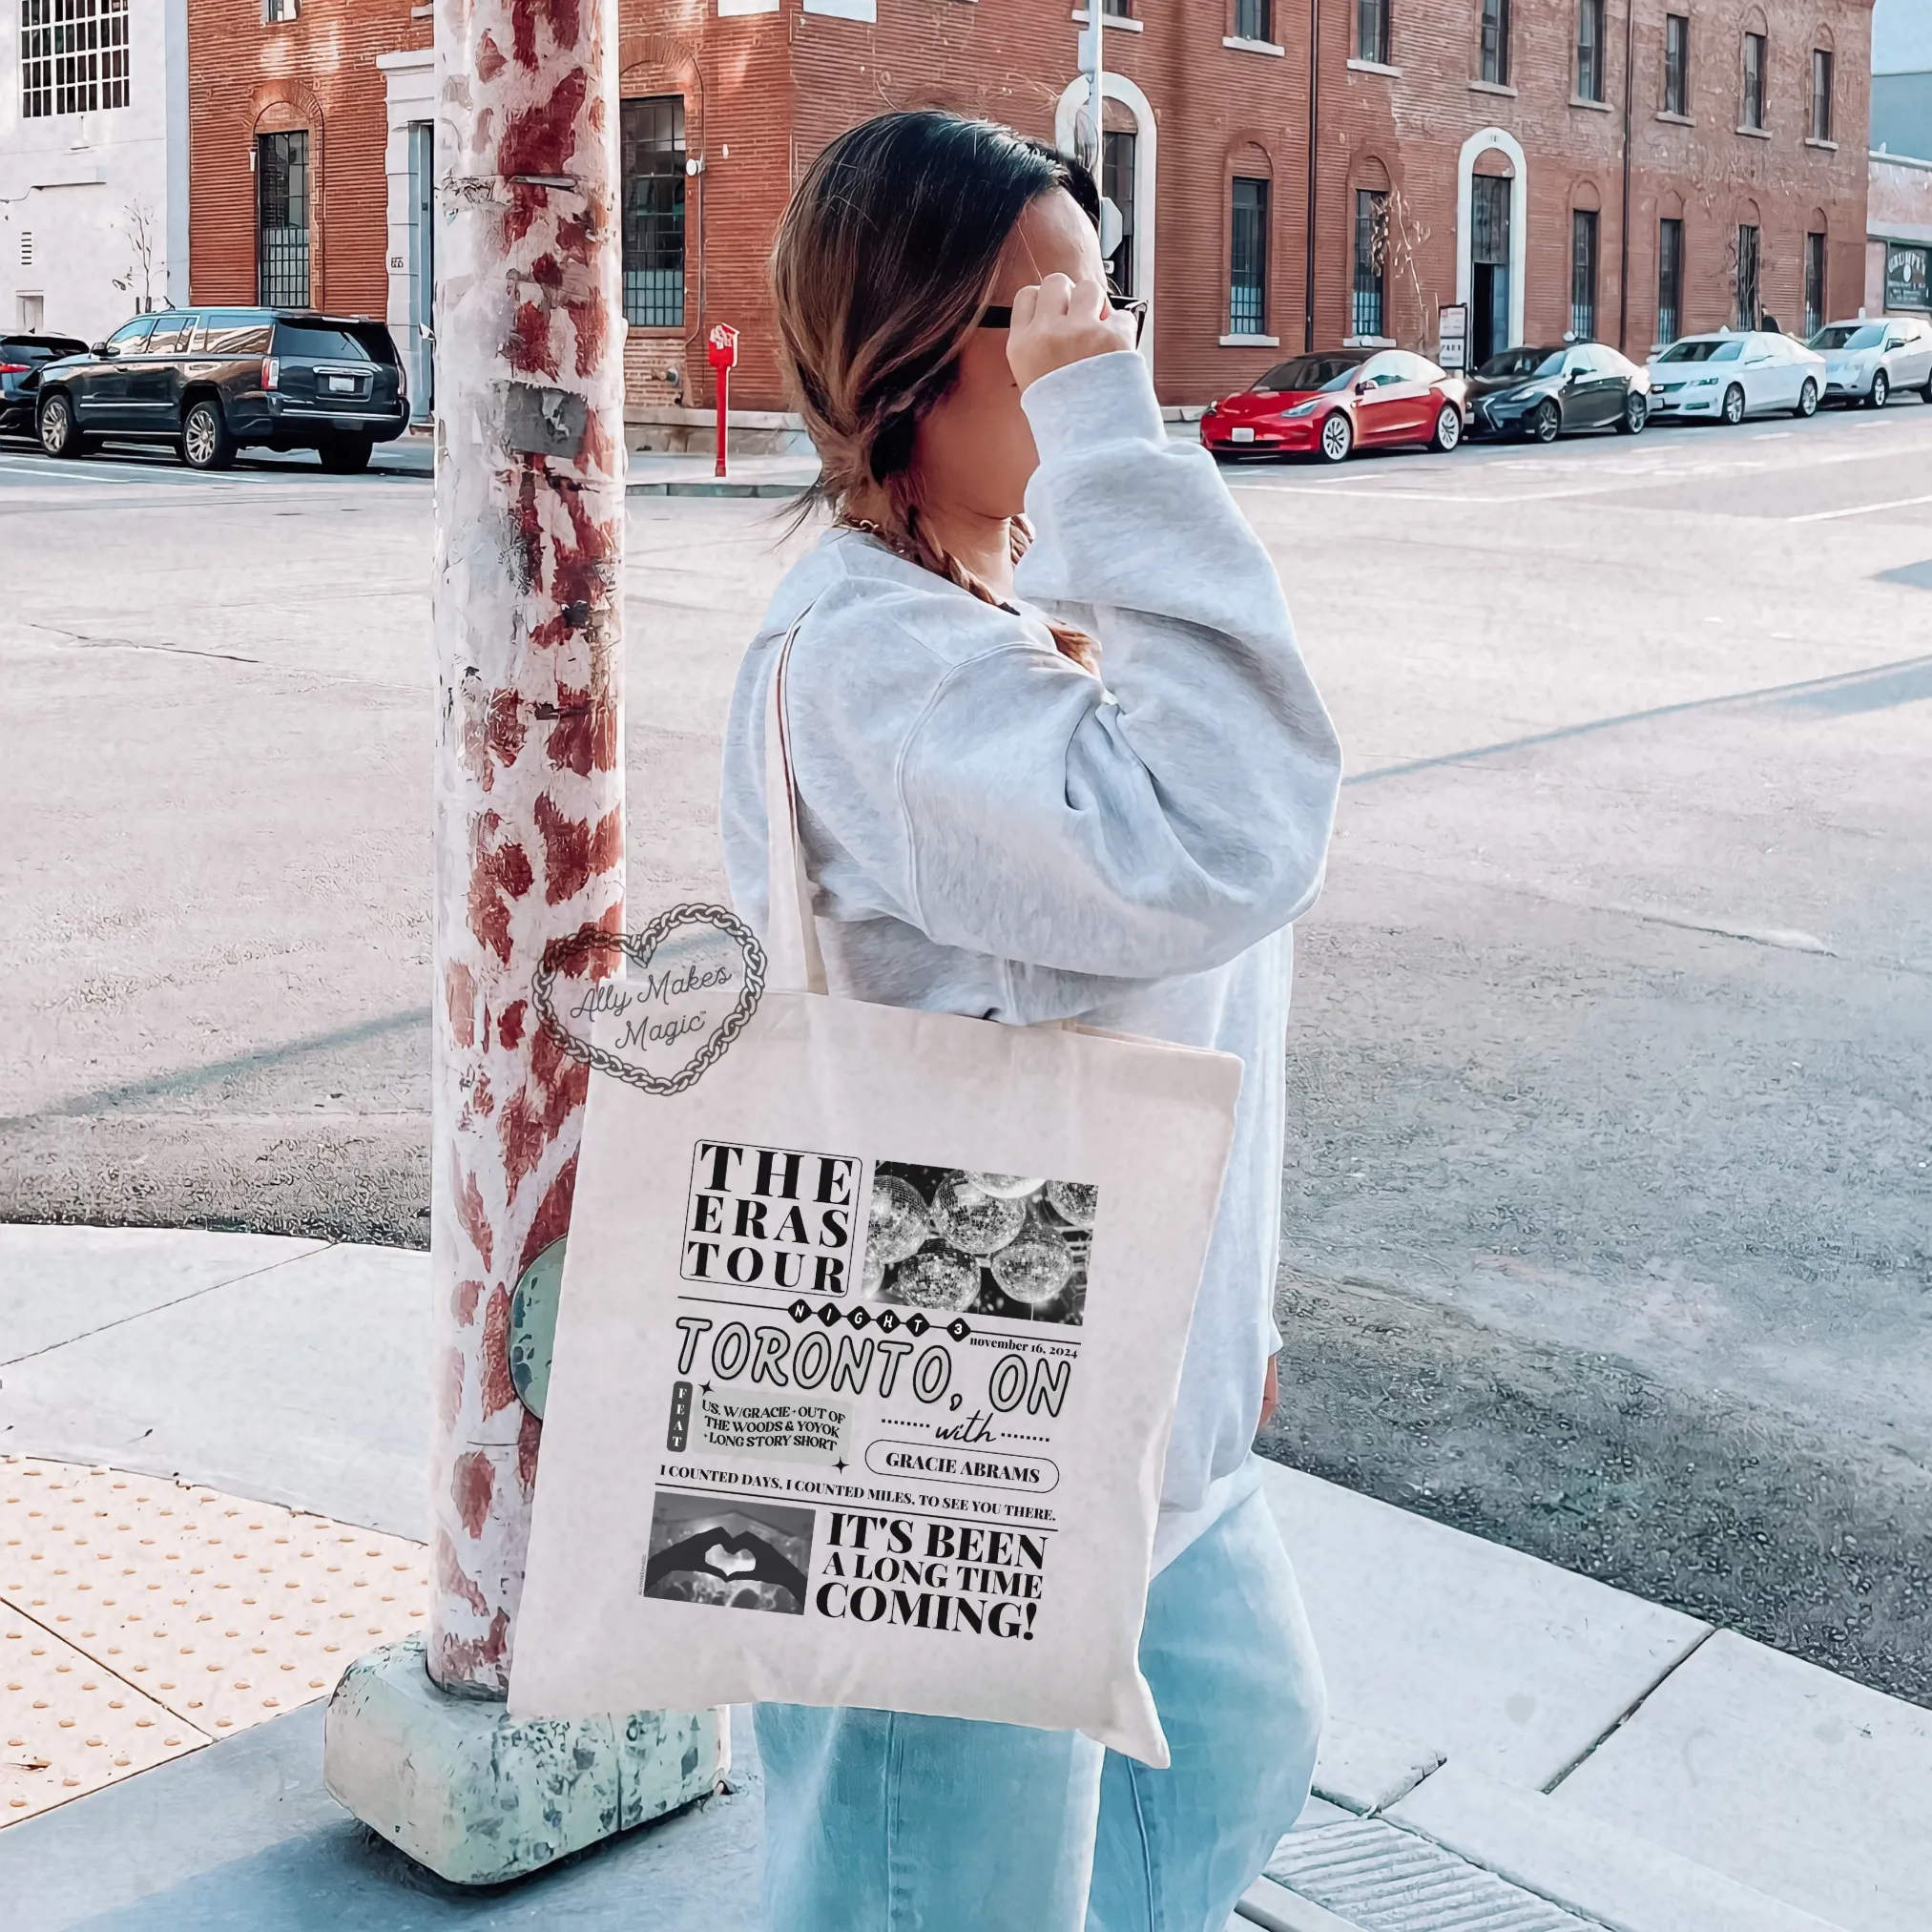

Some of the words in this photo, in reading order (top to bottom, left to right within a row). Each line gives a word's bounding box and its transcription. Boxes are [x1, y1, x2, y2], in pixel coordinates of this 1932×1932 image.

[701, 1144, 853, 1205] THE
[691, 1195, 848, 1248] ERAS
[687, 1241, 844, 1293] TOUR
[795, 1305, 922, 1332] NIGHT
[675, 1317, 963, 1411] TORONTO,
[988, 1354, 1070, 1418] ON
[969, 1337, 1028, 1353] november
[1030, 1343, 1047, 1356] 16,
[1049, 1346, 1078, 1360] 2024
[672, 1387, 687, 1446] FEAT
[702, 1399, 721, 1416] US.
[723, 1405, 791, 1419] W/GRACIE
[799, 1406, 827, 1420] OUT
[829, 1410, 846, 1424] OF
[704, 1415, 730, 1431] THE
[732, 1421, 783, 1433] WOODS
[784, 1422, 795, 1431] &
[797, 1421, 841, 1439] YOYOK
[935, 1409, 996, 1443] with
[746, 1435, 792, 1447] STORY
[793, 1435, 837, 1451] SHORT
[885, 1452, 957, 1474] GRACIE
[960, 1461, 1040, 1484] ABRAMS
[660, 1465, 666, 1476] I
[669, 1465, 738, 1484] COUNTED
[786, 1479, 792, 1490] I
[794, 1480, 864, 1499] COUNTED
[919, 1494, 940, 1508] TO
[942, 1497, 969, 1511] SEE
[971, 1500, 1002, 1515] YOU
[1005, 1505, 1056, 1522] THERE.
[827, 1512, 914, 1554] IT'S
[924, 1523, 1049, 1570] BEEN
[821, 1551, 845, 1577] A
[854, 1554, 948, 1589] LONG
[956, 1566, 1044, 1600] TIME
[816, 1582, 1038, 1641] COMING!
